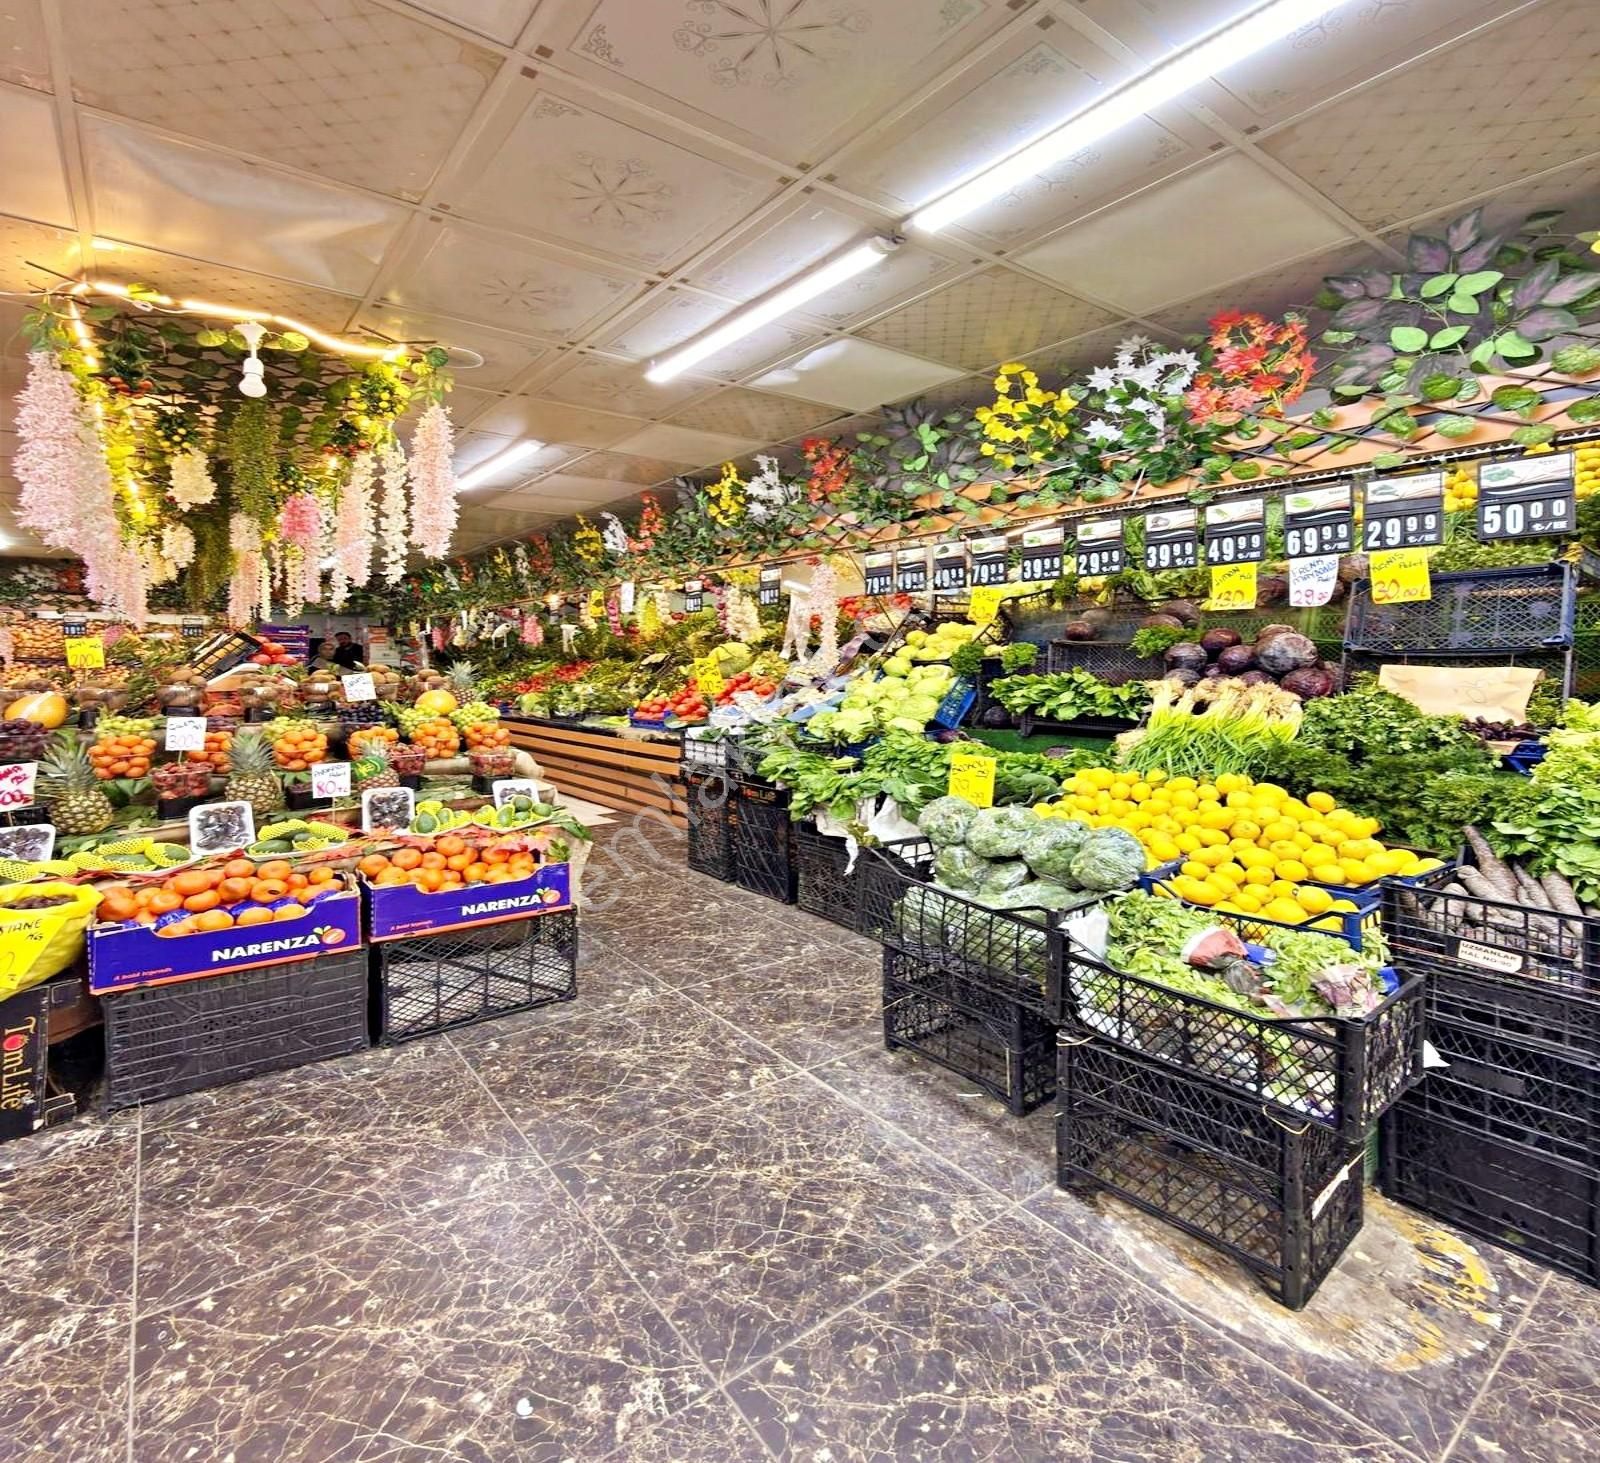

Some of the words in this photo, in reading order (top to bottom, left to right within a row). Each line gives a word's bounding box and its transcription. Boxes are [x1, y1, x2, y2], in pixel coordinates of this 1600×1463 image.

[316, 780, 337, 796] 80
[461, 894, 541, 916] NARENZA
[211, 933, 321, 962] NARENZA
